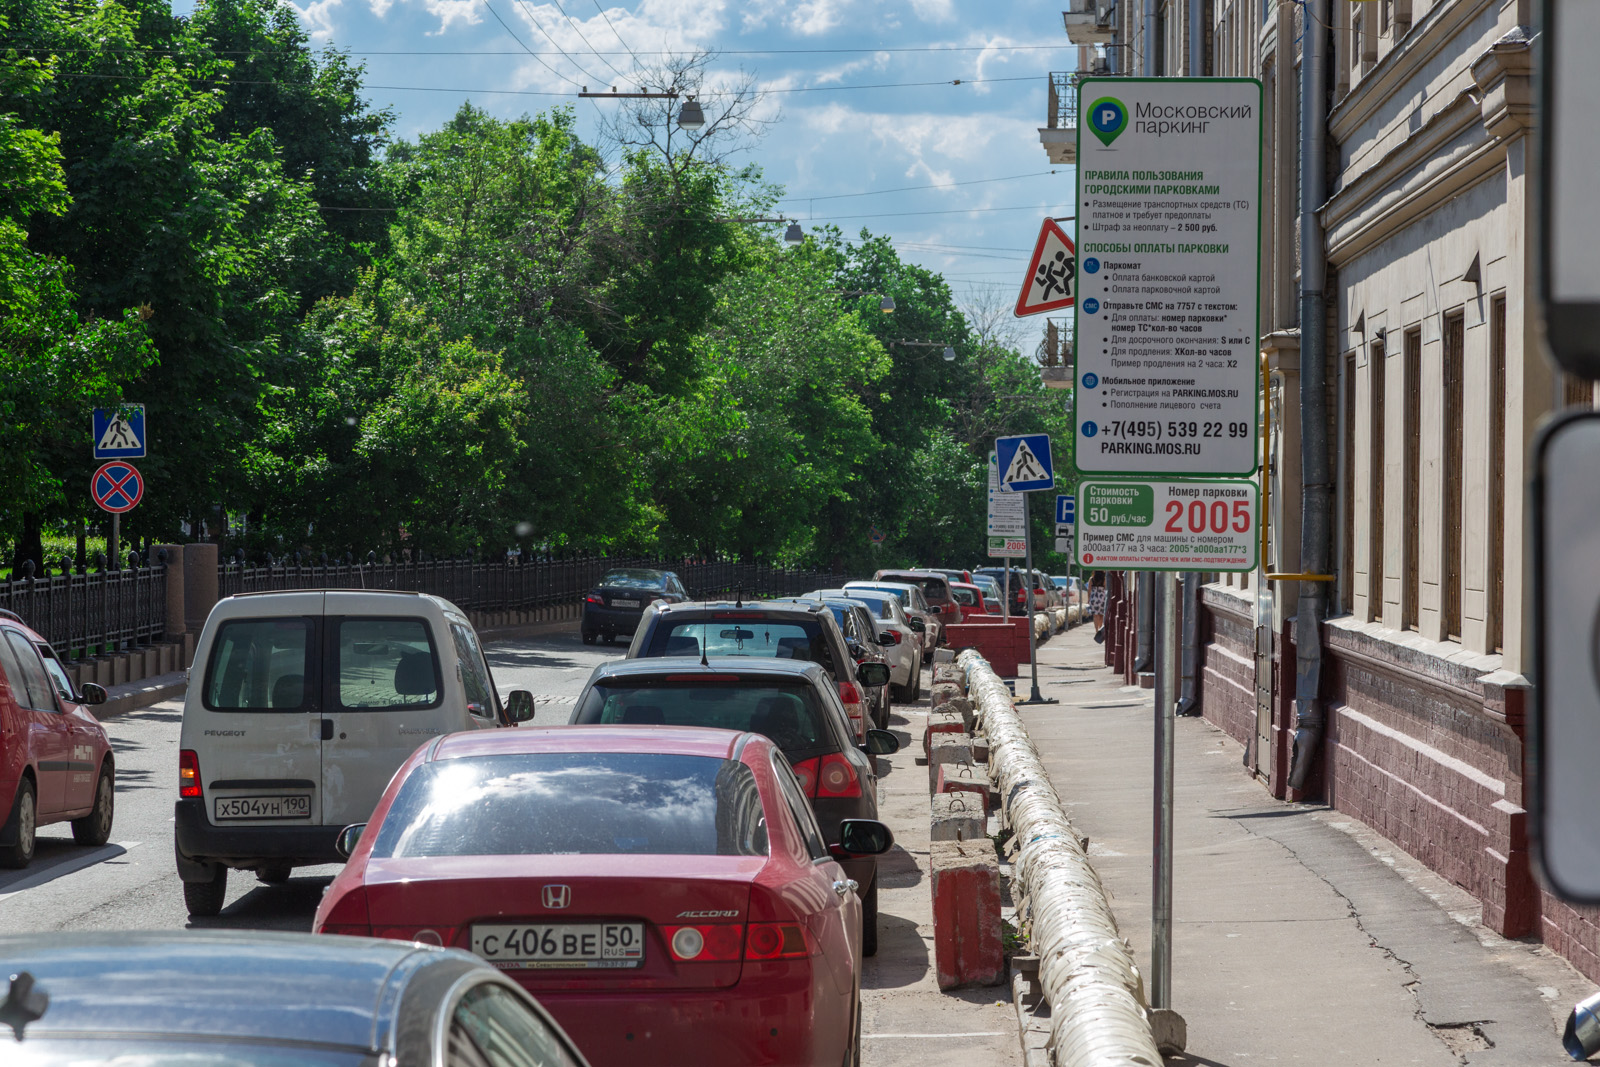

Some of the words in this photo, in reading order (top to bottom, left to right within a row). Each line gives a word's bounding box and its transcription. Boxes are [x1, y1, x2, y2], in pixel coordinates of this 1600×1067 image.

[1136, 102, 1251, 119] Московский
[1102, 110, 1116, 125] P
[1136, 121, 1210, 137] паркинг
[1085, 171, 1129, 181] ПРАВИЛА
[1132, 171, 1203, 181] ПОЛЬЗОВАНИЯ
[1084, 185, 1151, 196] ГОРОДСКИМИ
[1154, 185, 1219, 195] ПАРКОВКАМИ
[1092, 200, 1141, 209] Размещение
[1144, 201, 1198, 209] транспортных
[1200, 201, 1231, 209] средств
[1233, 200, 1249, 210] (ТС)
[1133, 212, 1162, 220] требует
[1165, 212, 1211, 220] предоплаты
[1092, 223, 1120, 232] Штраф
[1133, 224, 1168, 232] неоплату
[1202, 224, 1217, 233] руб.
[1084, 243, 1131, 253] СПОСОБЫ
[1134, 243, 1175, 253] ОПЛАТЫ
[1178, 244, 1229, 254] ПАРКОВКИ
[1103, 261, 1141, 270] Паркомат
[1112, 273, 1140, 282] Оплата
[1142, 274, 1186, 282] банковской
[1188, 274, 1215, 283] картой
[1112, 286, 1139, 294] Оплата
[1142, 286, 1192, 294] парковочной
[1194, 286, 1220, 295] картой
[1103, 301, 1143, 311] Отправьте
[1145, 302, 1163, 310] СМС
[1176, 302, 1195, 310] 7757
[1205, 303, 1237, 311] текстом:
[1111, 313, 1127, 323] Для
[1129, 315, 1159, 323] оплаты:
[1161, 315, 1185, 323] номер
[1111, 325, 1135, 333] номер
[1180, 325, 1202, 333] часов
[1111, 336, 1126, 345] Для
[1129, 337, 1174, 345] досрочного
[1176, 337, 1219, 345] окончания:
[1221, 337, 1226, 345] S
[1111, 347, 1126, 356] Для
[1128, 348, 1172, 357] продления:
[1209, 349, 1232, 357] часов
[1111, 359, 1141, 368] Пример
[1143, 360, 1185, 369] продления
[1198, 360, 1203, 368] 2
[1102, 376, 1146, 385] Мобильное
[1148, 377, 1195, 386] приложение
[1111, 389, 1159, 397] Регистрация
[1172, 389, 1239, 398] PARKING.MOS.RU
[1110, 400, 1157, 409] Пополнение
[1159, 402, 1195, 410] лицевого
[1200, 402, 1221, 410] счета
[1101, 421, 1162, 439] +7(495)
[1168, 422, 1197, 438] 539
[1203, 422, 1222, 438] 22
[1229, 422, 1248, 438] 99
[1101, 443, 1201, 455] PARKING.MOS.RU
[1090, 486, 1139, 497] Стоимость
[1168, 486, 1200, 497] Номер
[1202, 487, 1247, 498] парковки
[1090, 496, 1132, 506] парковки
[1090, 508, 1109, 523] 50
[1111, 513, 1147, 524] руб./час
[1164, 500, 1251, 533] 2005
[1083, 533, 1114, 542] Пример
[1116, 533, 1135, 542] СМС
[1137, 534, 1151, 543] для
[1154, 535, 1188, 543] машины
[1197, 536, 1234, 544] номером
[1007, 542, 1026, 550] 2005
[1128, 544, 1137, 552] на
[1139, 544, 1144, 552] 3
[1146, 544, 1167, 553] часа:
[284, 797, 306, 810] 190
[676, 910, 740, 918] ACCORD
[606, 926, 633, 947] 50
[604, 948, 625, 957] RUS
